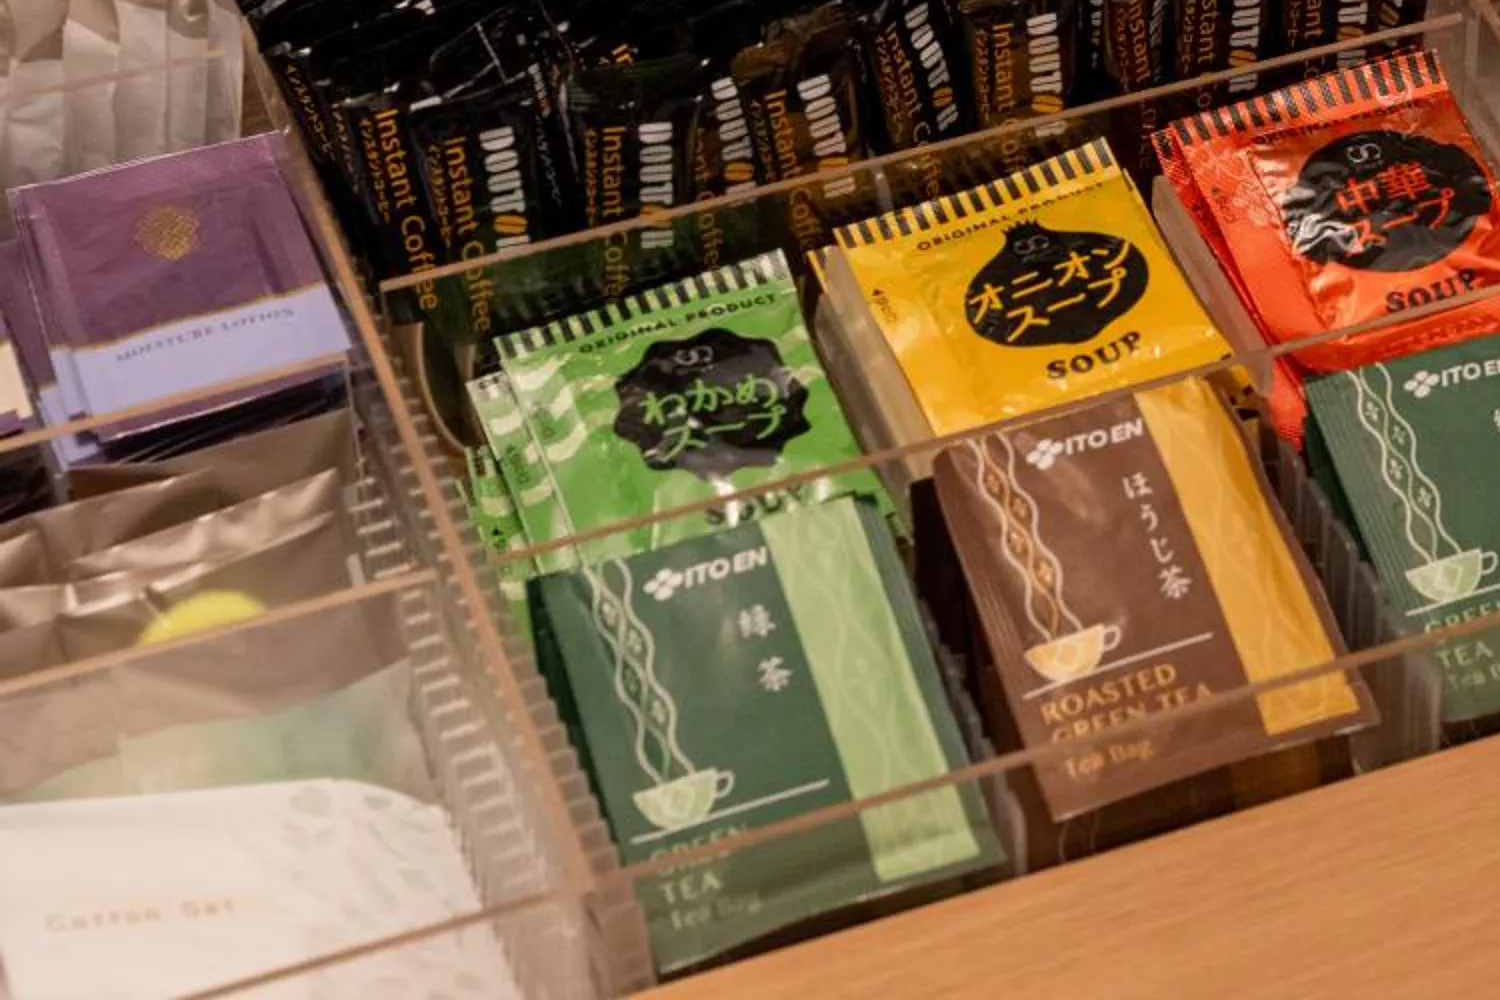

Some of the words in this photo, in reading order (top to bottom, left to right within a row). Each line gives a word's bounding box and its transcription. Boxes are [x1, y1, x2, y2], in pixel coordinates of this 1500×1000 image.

[885, 21, 923, 116] Instant
[904, 2, 960, 132] DOUTOR
[993, 23, 1017, 112] Instant
[1026, 13, 1068, 137] DOUTOR
[764, 89, 801, 179] Instant
[797, 74, 856, 198] DOUTOR
[602, 125, 627, 218] Instant
[639, 121, 674, 249] DOUTOR
[1335, 160, 1432, 213] 中華
[374, 108, 417, 209] Instant
[401, 215, 440, 310] Coffee
[444, 136, 480, 237] Instant
[462, 240, 494, 333] Coffee
[916, 214, 1011, 252] ORIGINAL
[1347, 187, 1455, 248] スープ
[971, 240, 1132, 326] オニオン
[1006, 269, 1127, 343] スープ
[1384, 268, 1479, 314] SOUP
[115, 326, 217, 363] MOISTURE
[221, 306, 297, 333] LOTION
[578, 318, 680, 354] ORIGINAL
[683, 293, 778, 322] PRODUCT
[1046, 331, 1142, 380] SOUP
[639, 373, 778, 427] わかめ
[1440, 361, 1483, 387] ITO
[661, 403, 788, 463] スープ
[1063, 430, 1108, 456] ITO
[1110, 417, 1145, 442] EN
[1122, 471, 1192, 600] ほうじ茶
[680, 560, 731, 590] ITO
[733, 546, 769, 571] EN
[737, 603, 793, 693] 緑茶
[1434, 641, 1494, 670] TEA
[1039, 662, 1178, 726] ROASTED
[1051, 702, 1149, 745] GREEN
[1155, 680, 1213, 712] TEA
[659, 869, 724, 905] TEA
